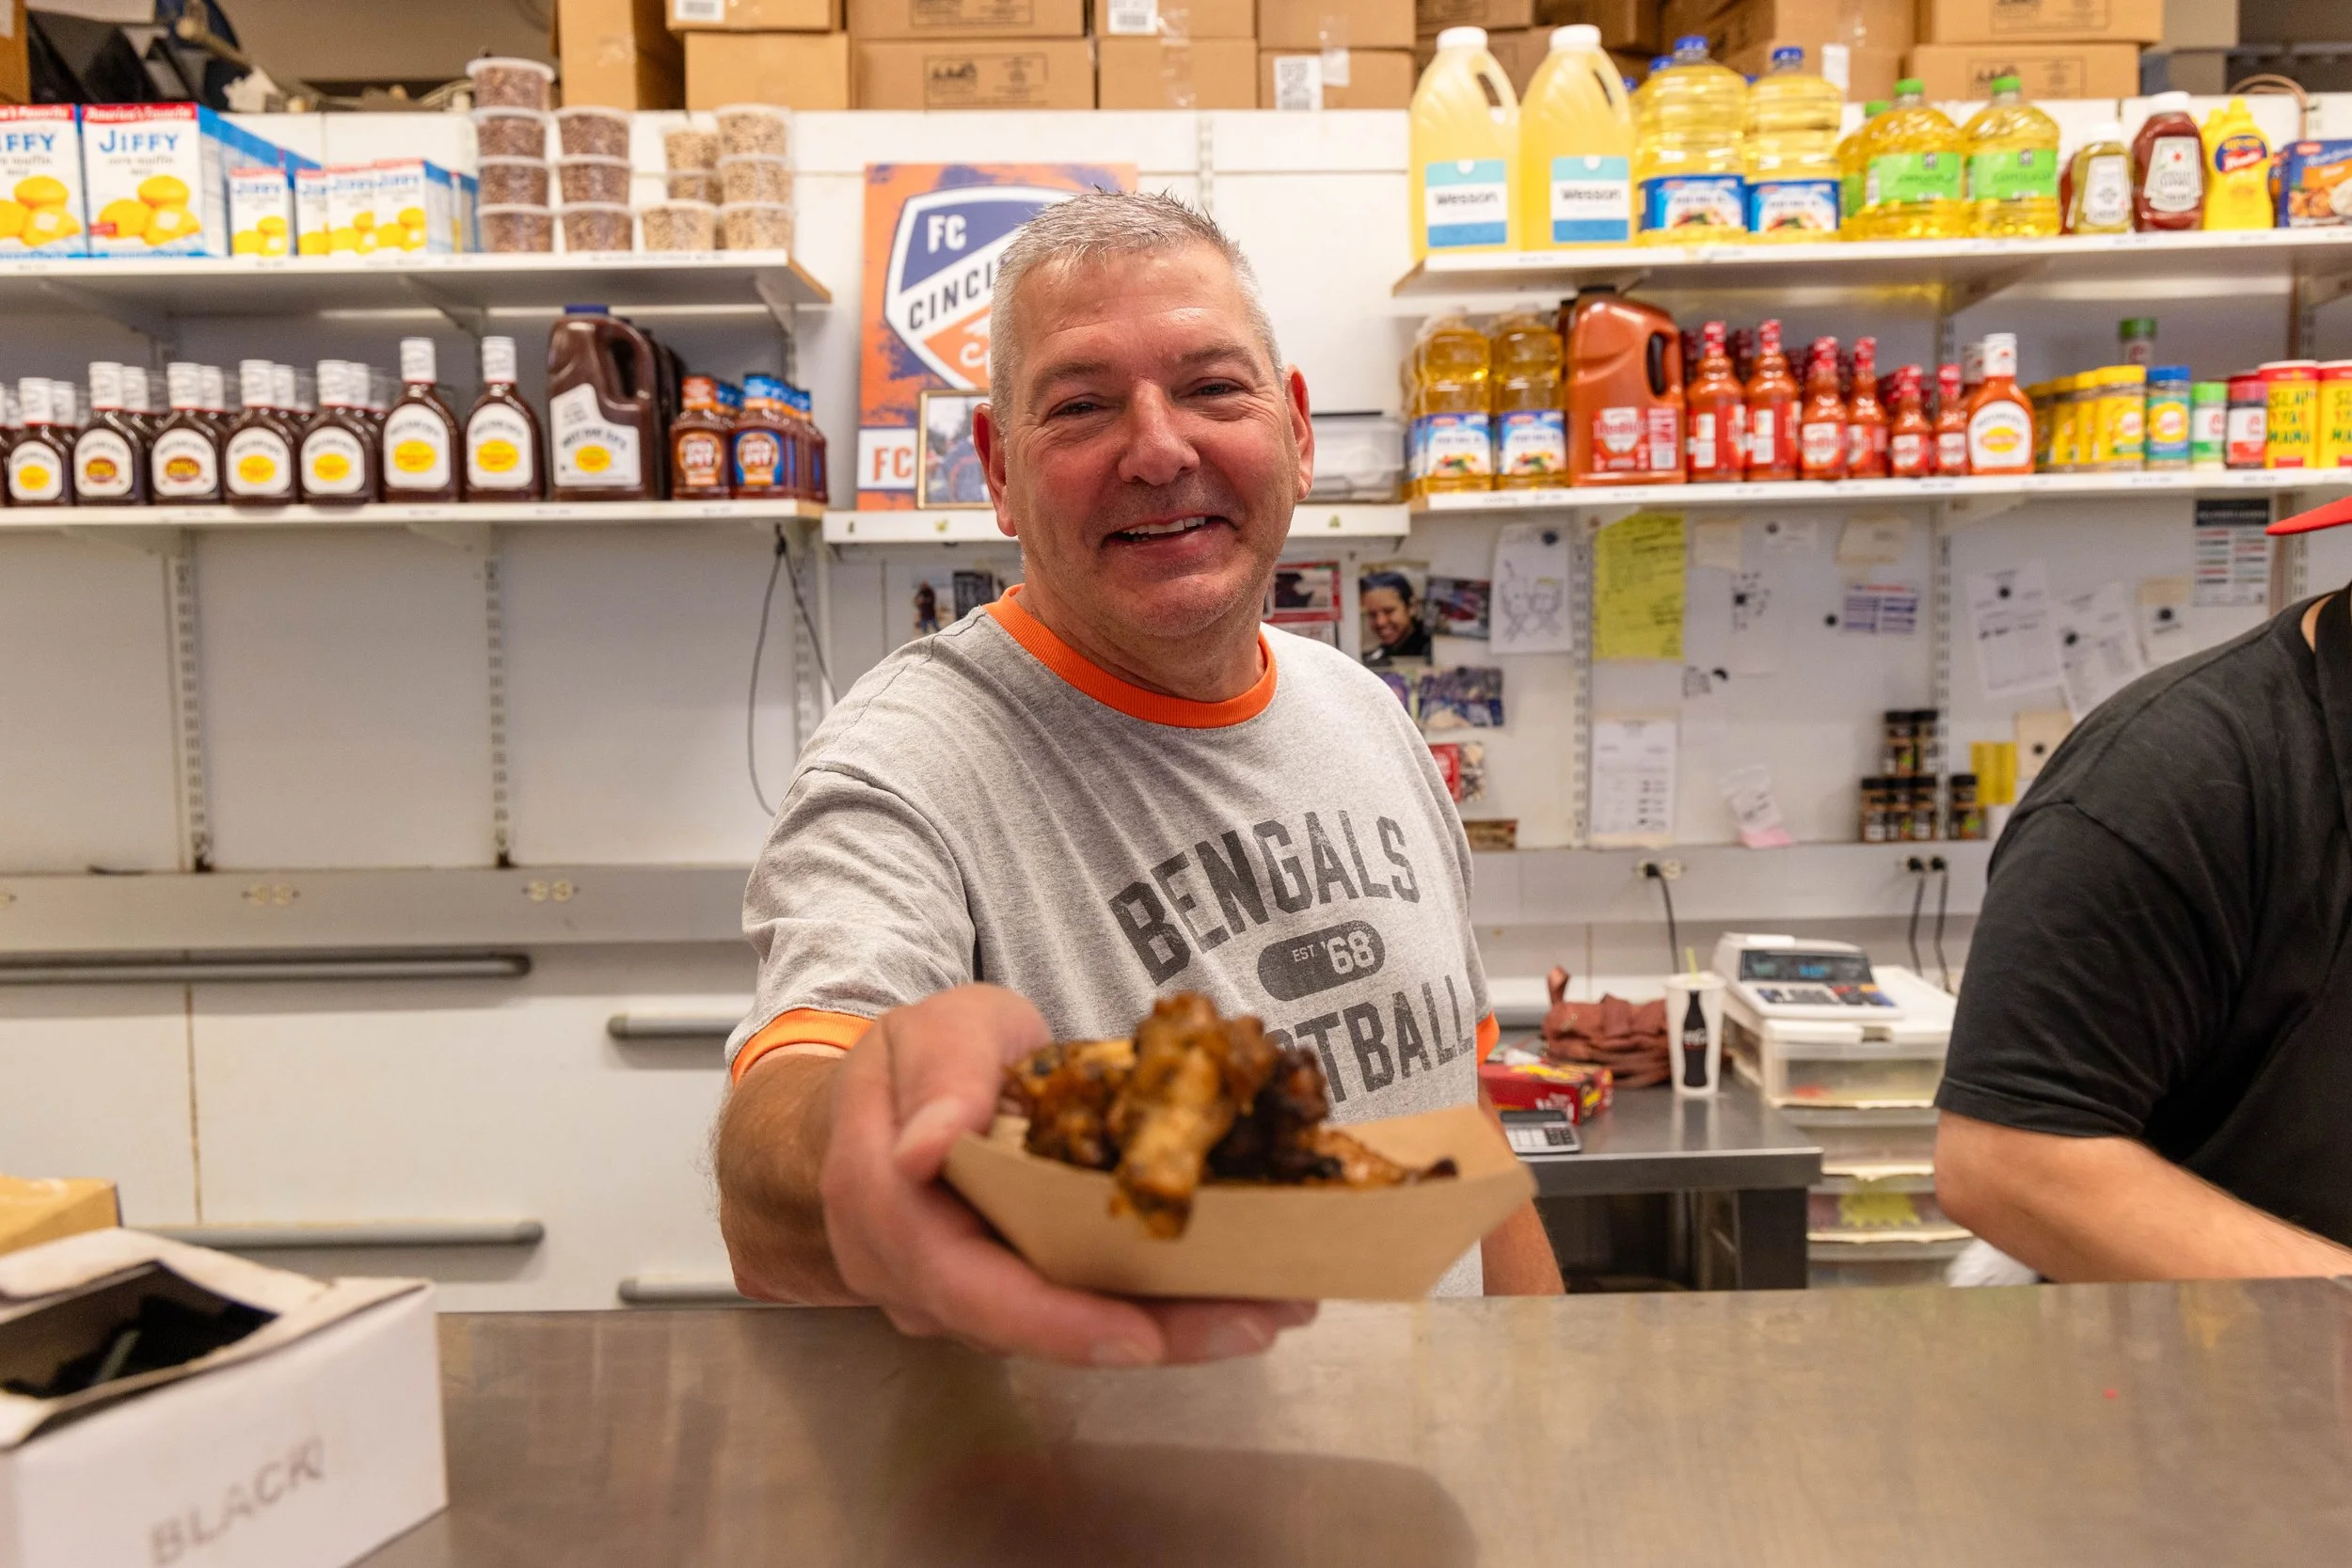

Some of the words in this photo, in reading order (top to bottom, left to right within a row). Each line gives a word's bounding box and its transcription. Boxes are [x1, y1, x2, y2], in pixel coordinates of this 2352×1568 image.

[0, 134, 56, 151] FFY
[928, 214, 967, 254] FC
[908, 261, 992, 331] CINCI
[874, 446, 913, 483] FC
[1108, 810, 1421, 986] BENGALS
[1292, 943, 1315, 962] EST
[1323, 929, 1376, 974] '68
[1266, 974, 1474, 1103] TBALL
[151, 1436, 325, 1565] BLACK
